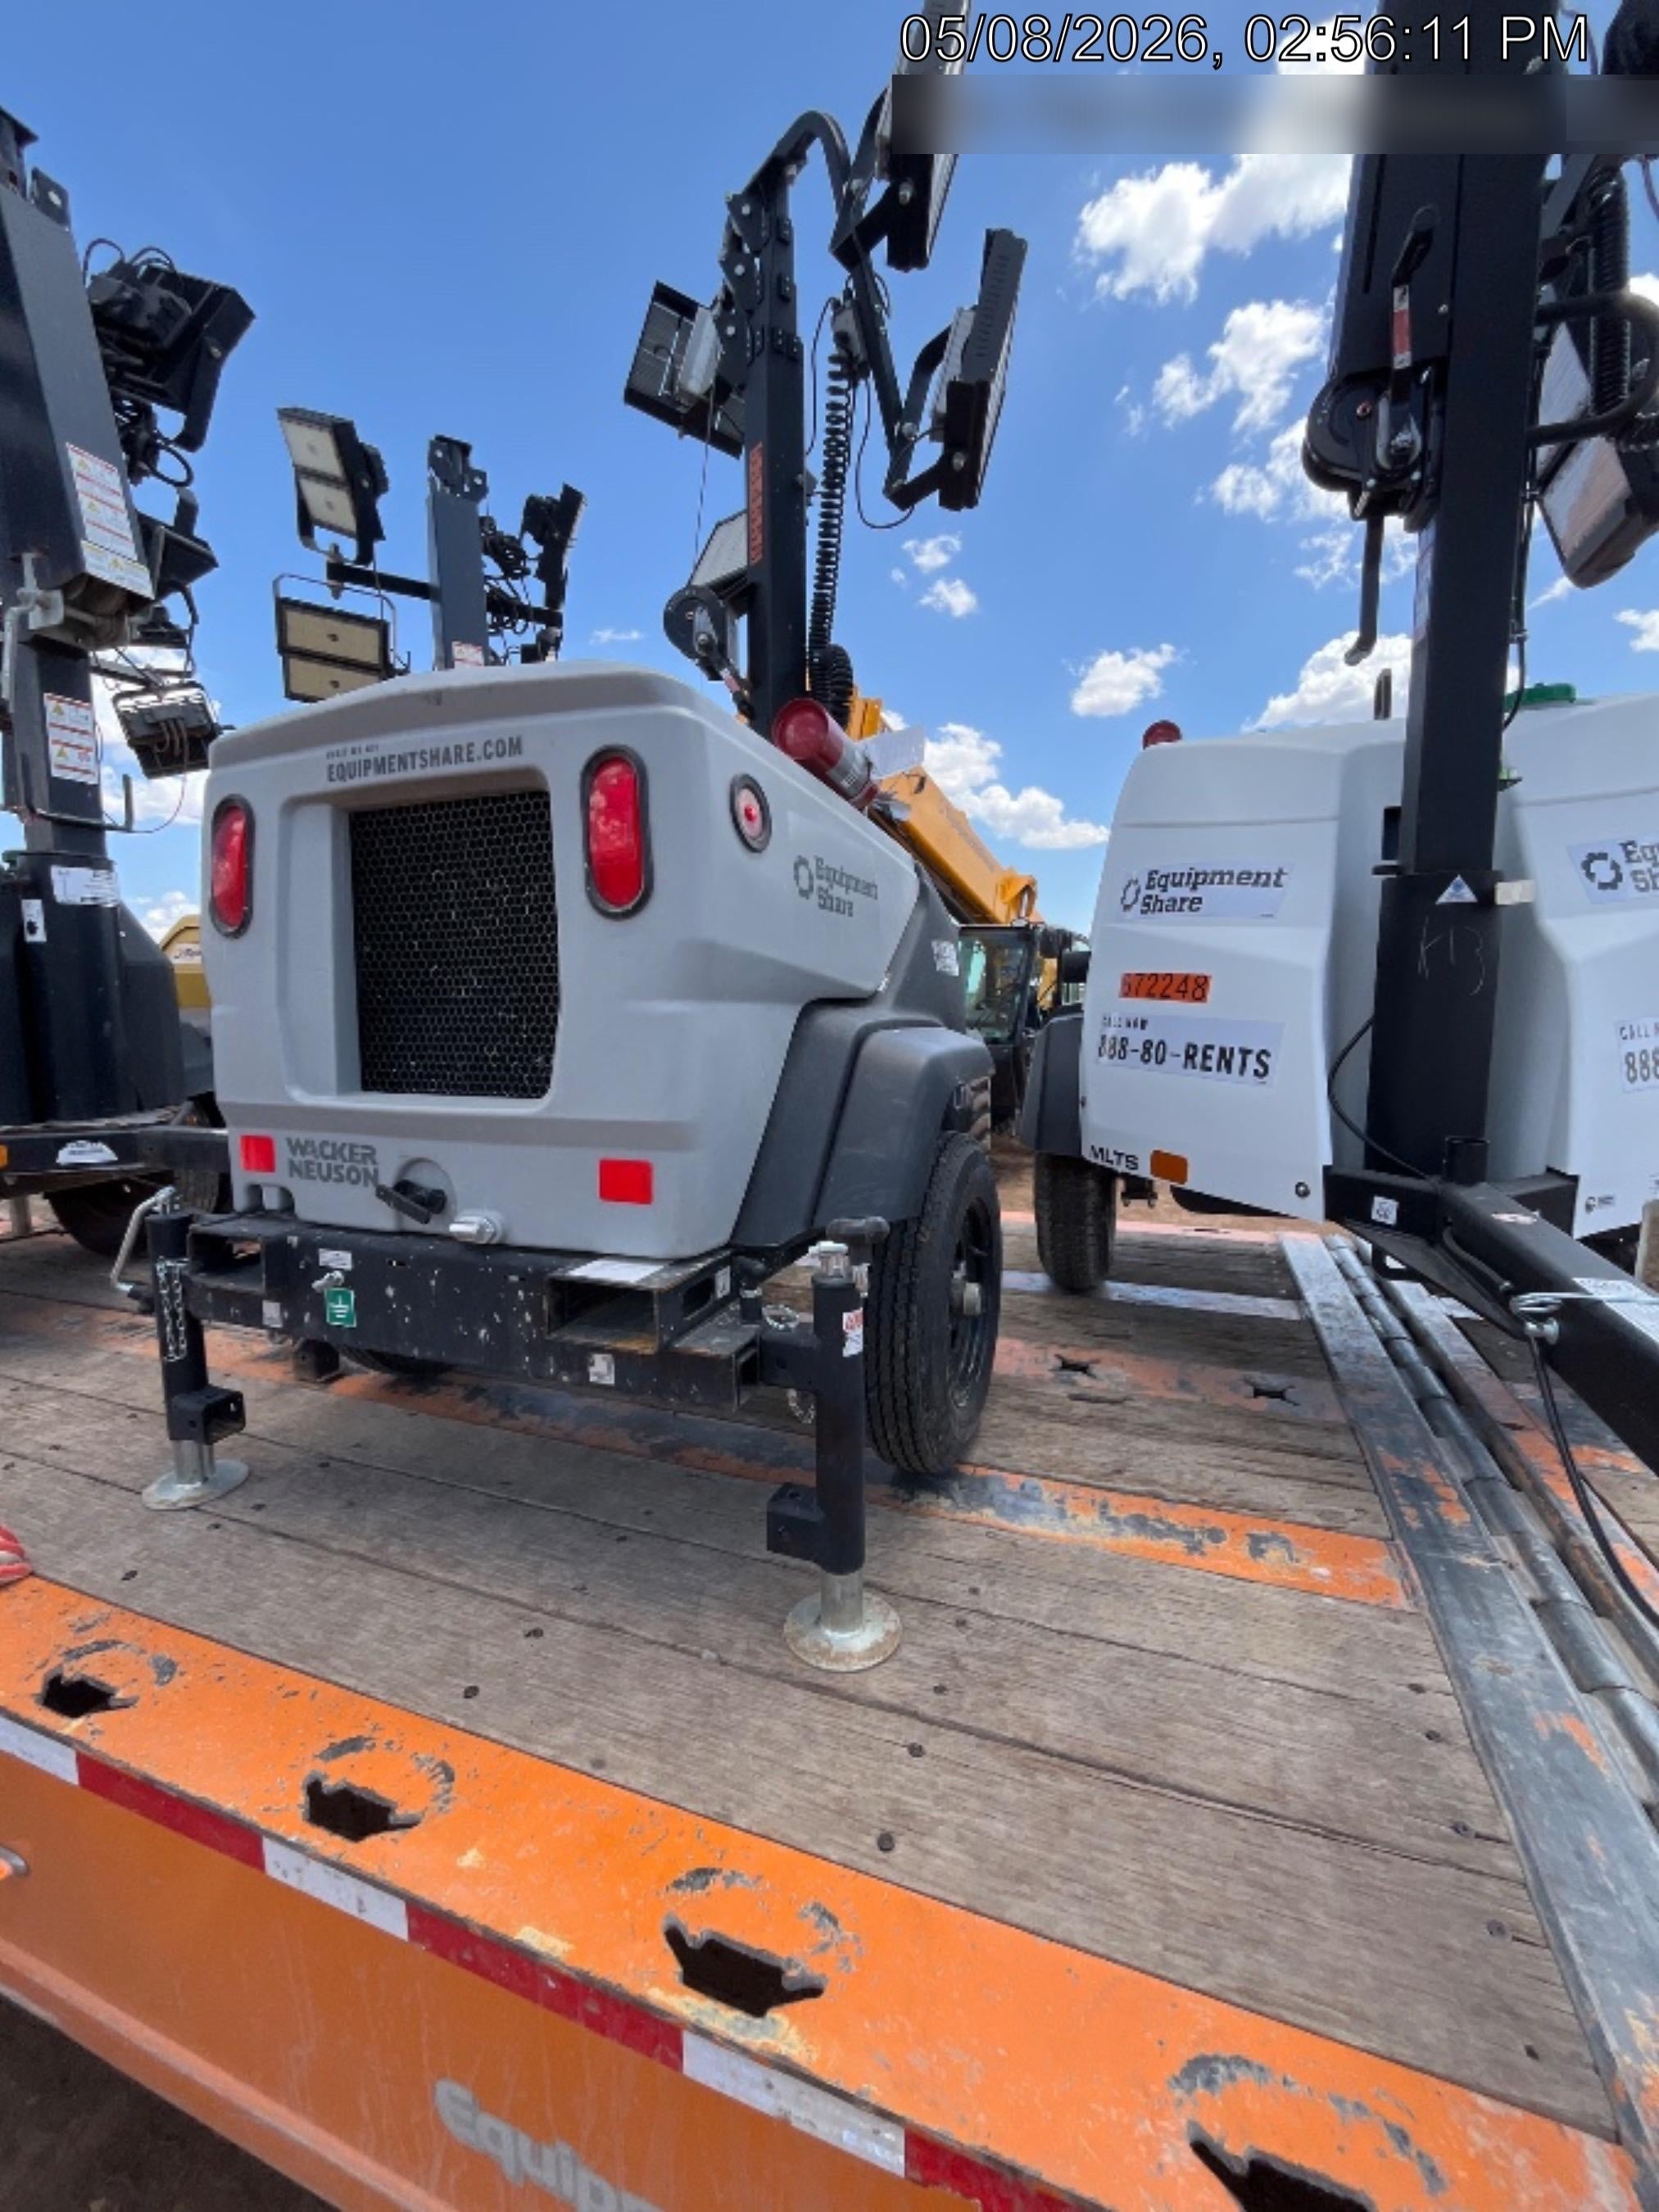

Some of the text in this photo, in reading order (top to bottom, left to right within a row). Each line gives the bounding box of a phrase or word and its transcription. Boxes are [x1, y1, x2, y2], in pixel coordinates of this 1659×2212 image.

[327, 736, 523, 782] EQUIPMENTSHARE.COM
[1619, 840, 1659, 868] Eq
[813, 854, 879, 900] Equipment
[1145, 867, 1288, 893] Equipment
[818, 886, 854, 918] Share
[1140, 894, 1203, 915] Share
[1098, 1034, 1271, 1079] 888-80-RENTS
[285, 1136, 378, 1165] WACKER
[1090, 1145, 1139, 1171] MLTS
[288, 1157, 379, 1188] NEUSON
